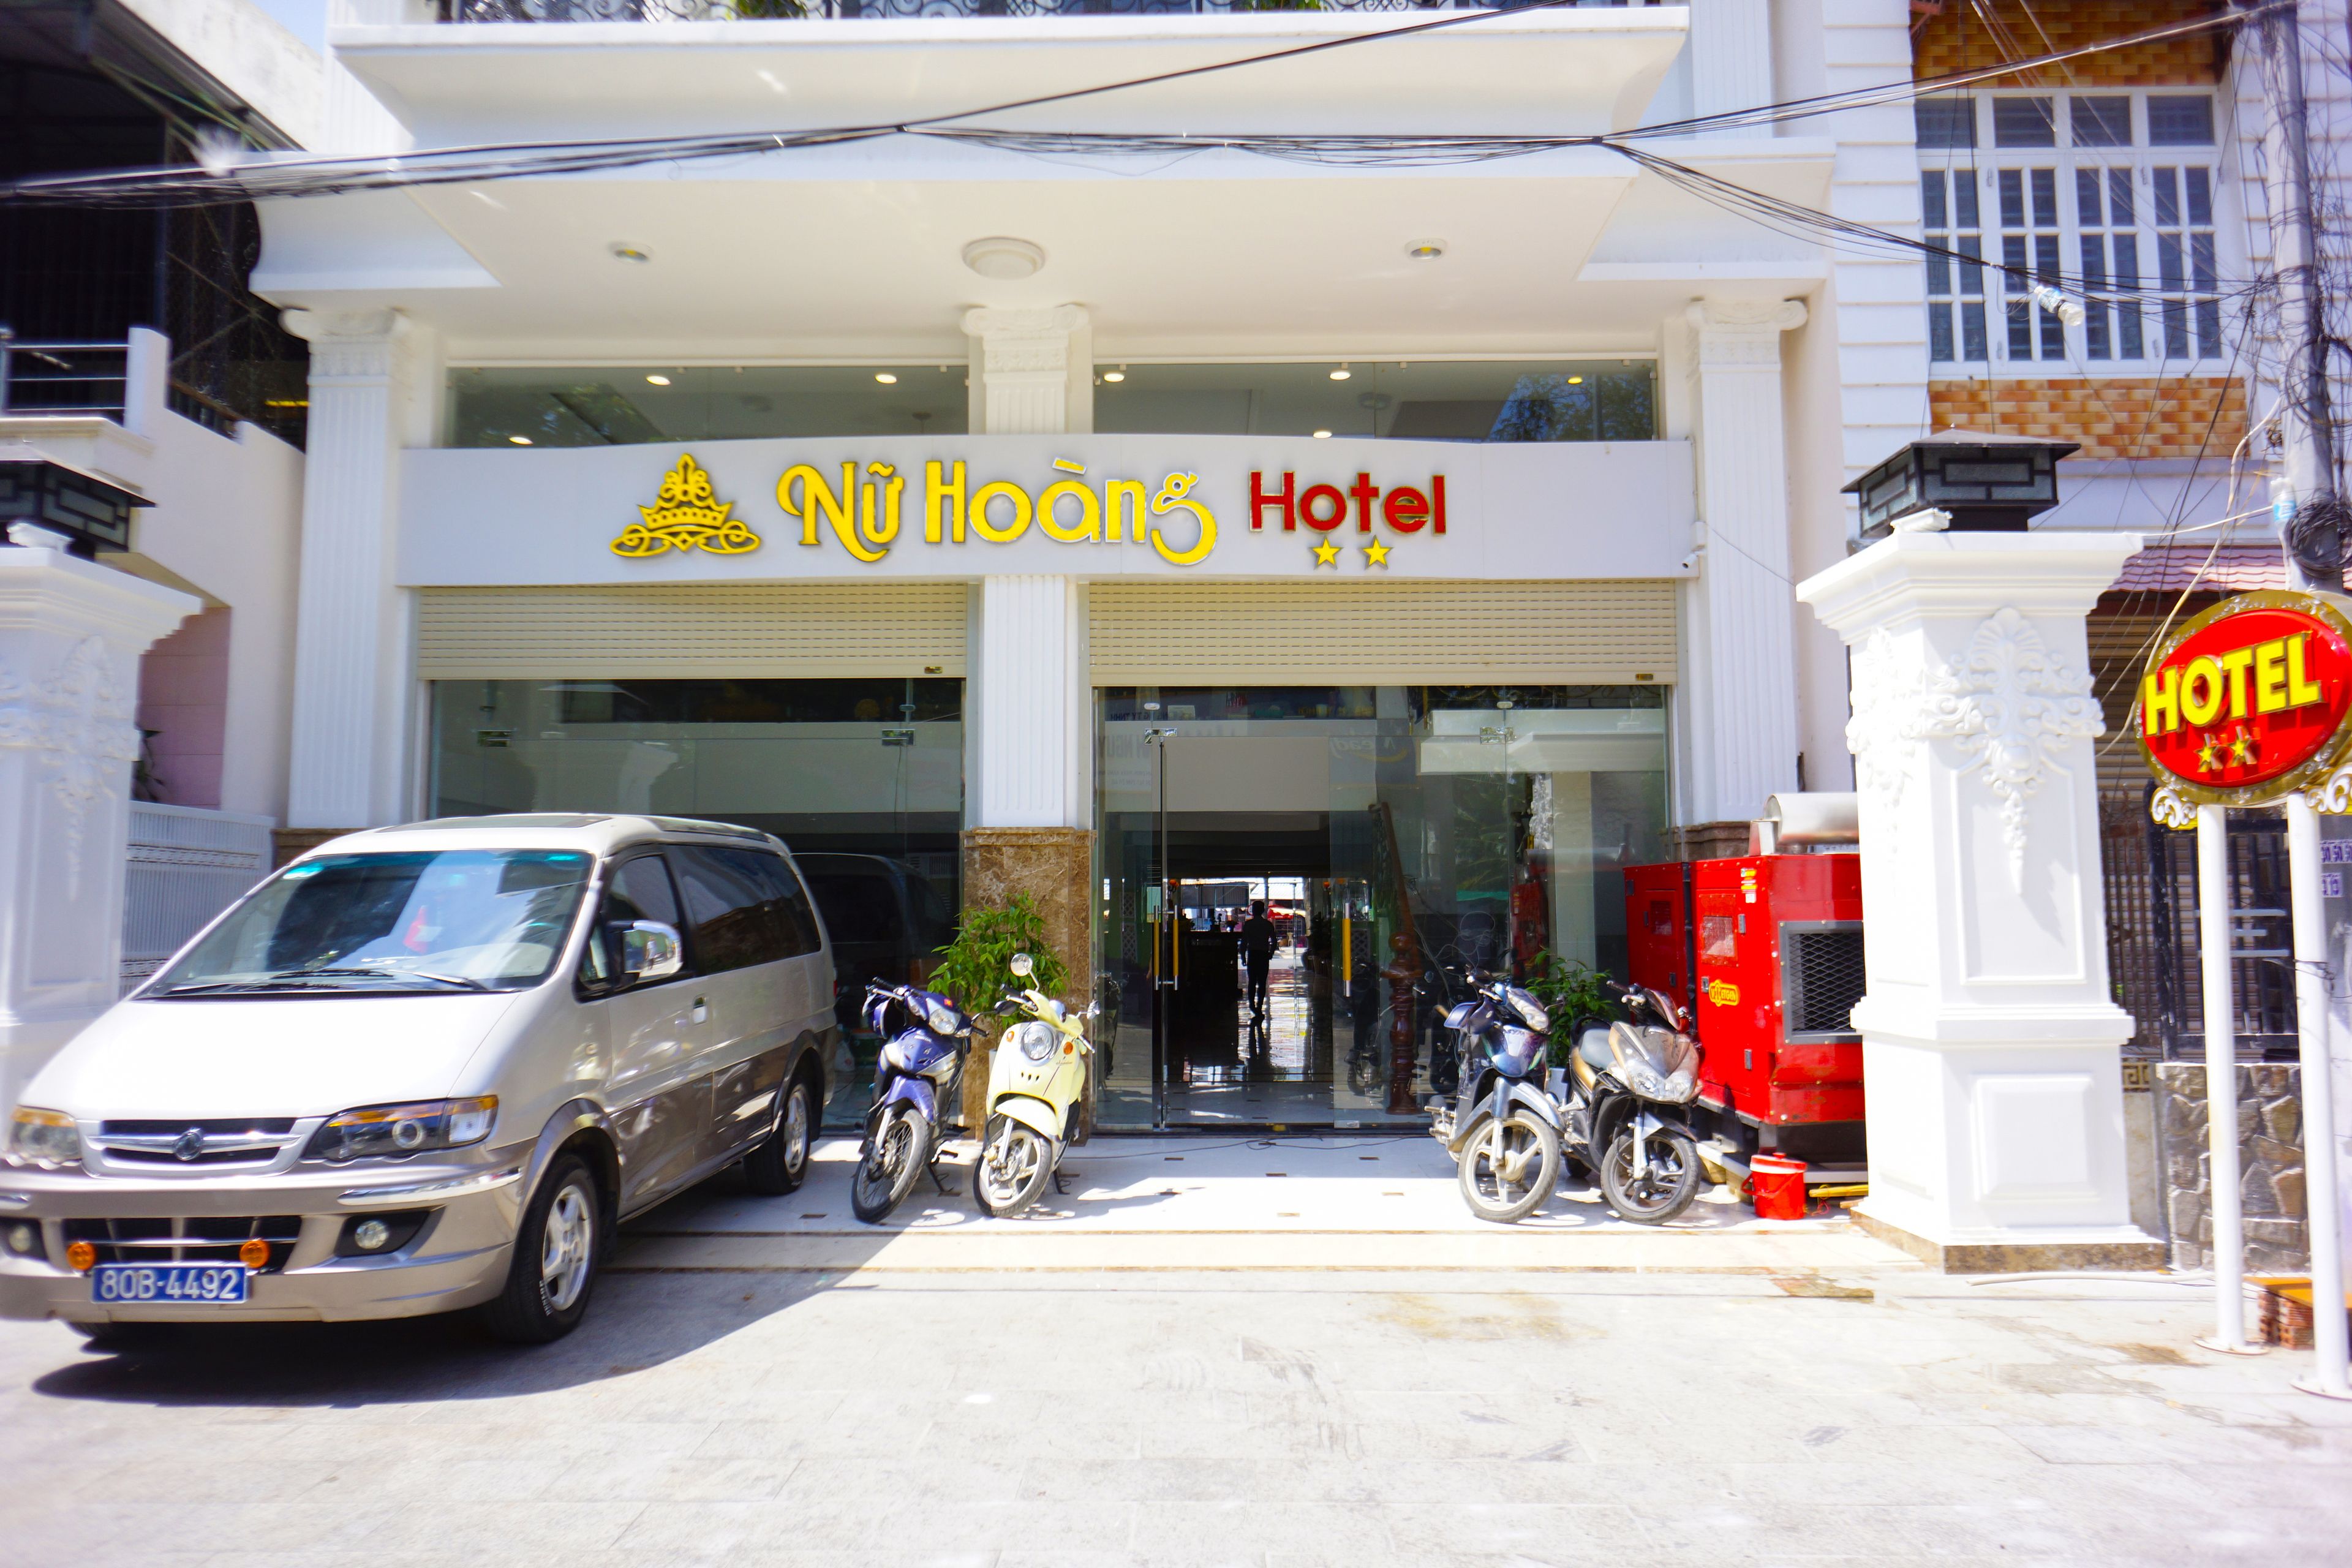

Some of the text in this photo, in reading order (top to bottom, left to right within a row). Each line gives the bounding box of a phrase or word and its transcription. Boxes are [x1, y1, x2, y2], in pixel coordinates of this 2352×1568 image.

[776, 458, 1447, 565] Nữ Hoàng Hotel
[2144, 633, 2321, 736] HOTEL
[100, 1269, 240, 1300] 80B-4492
